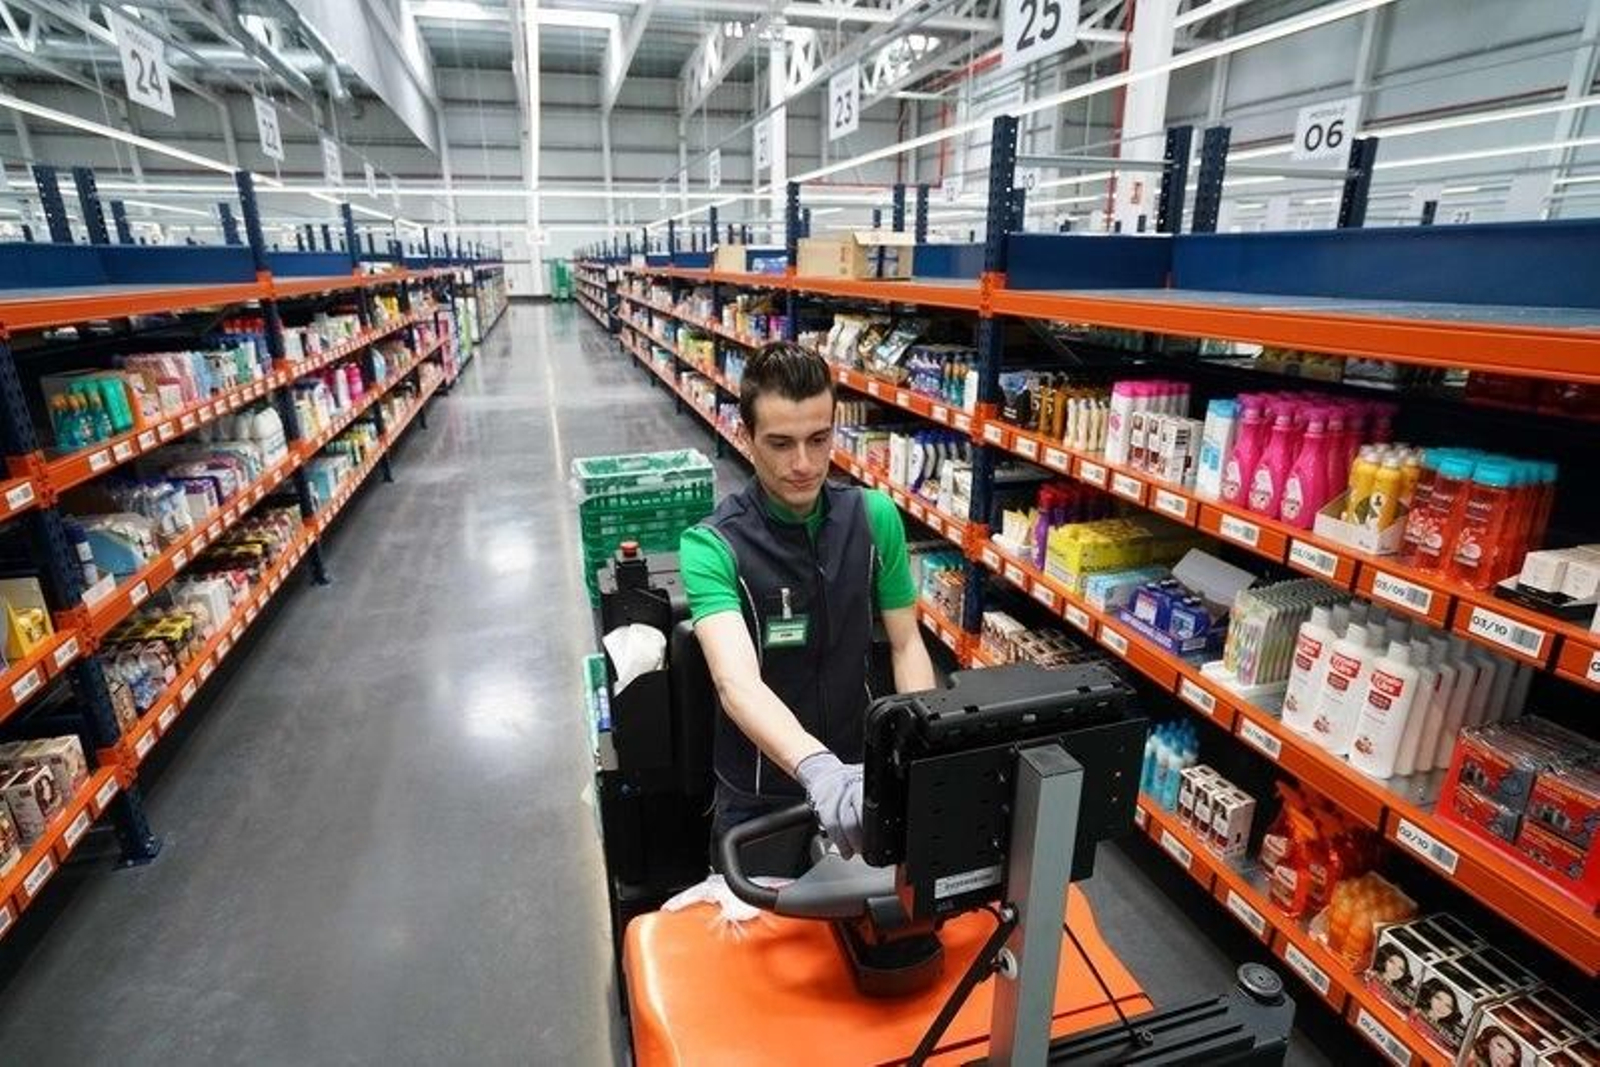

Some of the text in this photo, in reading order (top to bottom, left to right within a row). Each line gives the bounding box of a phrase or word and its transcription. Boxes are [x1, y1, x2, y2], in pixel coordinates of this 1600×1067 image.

[1016, 0, 1061, 52] 25
[130, 49, 163, 101] 24
[834, 89, 853, 128] 23
[1304, 119, 1344, 151] 06
[1376, 580, 1406, 597] 03/09
[1473, 616, 1509, 636] 03/10
[1399, 826, 1429, 850] 02/10
[1360, 1017, 1387, 1043] 01/10
